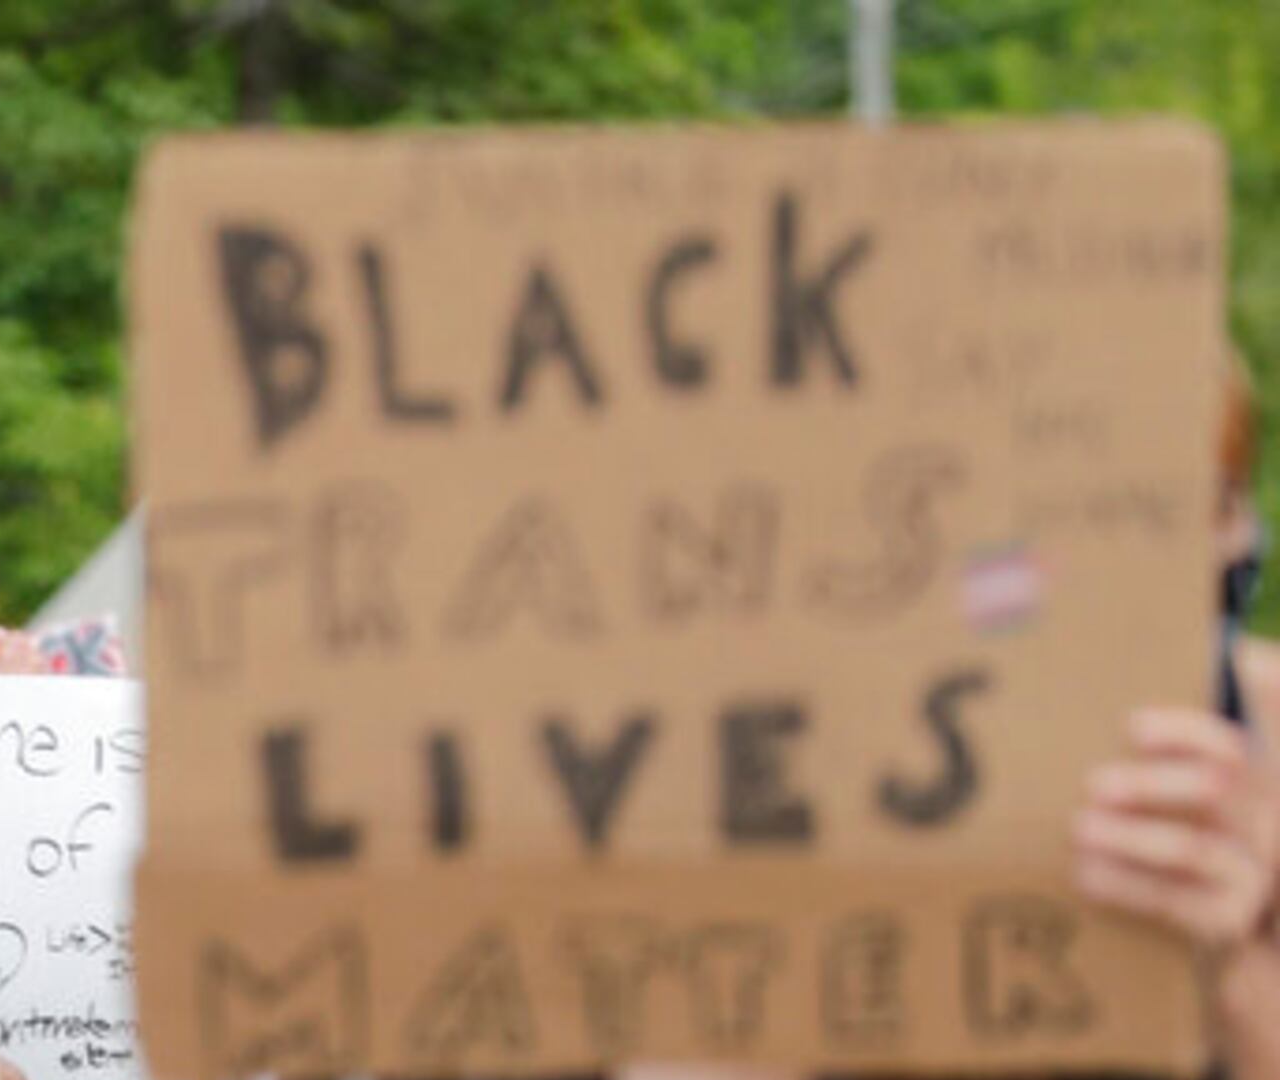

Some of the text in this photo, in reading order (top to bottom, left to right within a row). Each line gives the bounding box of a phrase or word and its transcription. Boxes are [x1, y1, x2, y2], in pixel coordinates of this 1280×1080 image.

[215, 186, 874, 452] BLACK
[146, 444, 972, 687] TRANS
[26, 801, 113, 878] of
[257, 669, 996, 865] LIVES
[195, 896, 1095, 1074] MATTER
